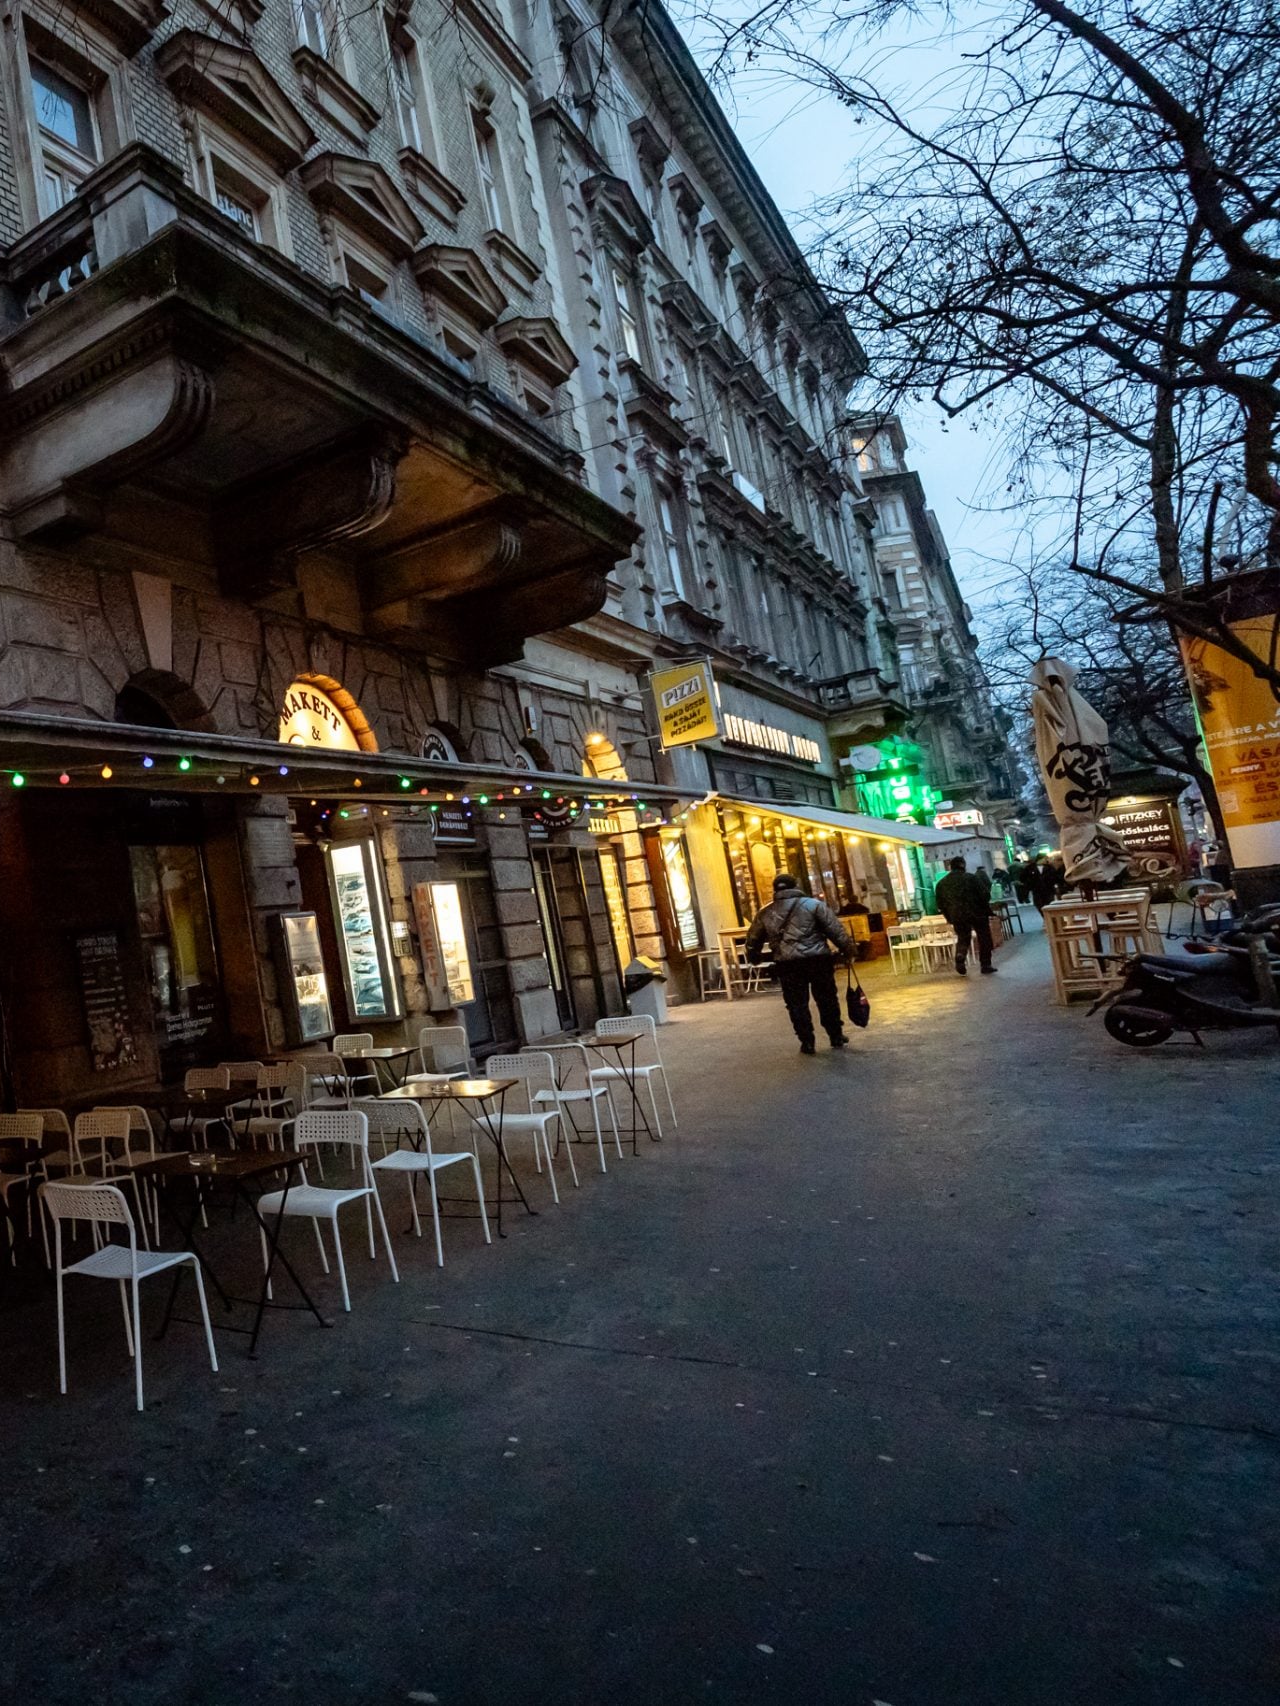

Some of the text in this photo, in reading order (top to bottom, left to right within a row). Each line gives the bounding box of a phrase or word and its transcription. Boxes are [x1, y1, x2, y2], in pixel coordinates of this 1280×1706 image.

[280, 691, 341, 731] MAKETT
[311, 725, 321, 741] &
[1118, 808, 1163, 822] FITZKEY
[1114, 824, 1170, 836] tőskalács
[1148, 834, 1171, 843] Cake
